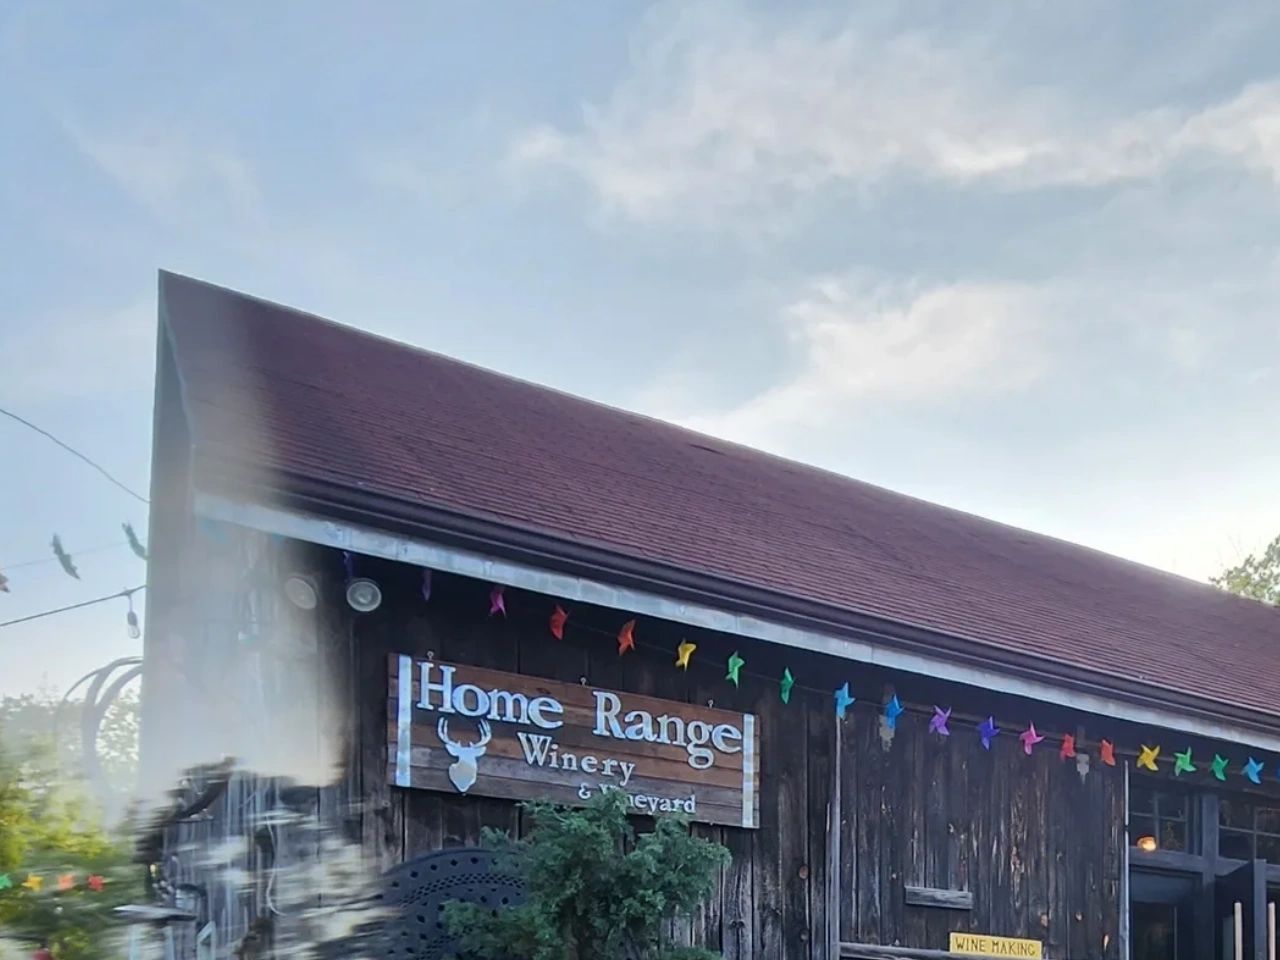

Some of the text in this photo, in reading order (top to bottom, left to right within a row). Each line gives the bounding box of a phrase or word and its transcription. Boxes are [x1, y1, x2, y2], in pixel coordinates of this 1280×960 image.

[416, 661, 742, 770] Home Range
[516, 731, 636, 787] Winery
[578, 782, 697, 816] & neyard
[955, 936, 1036, 957] WINE MAKING
